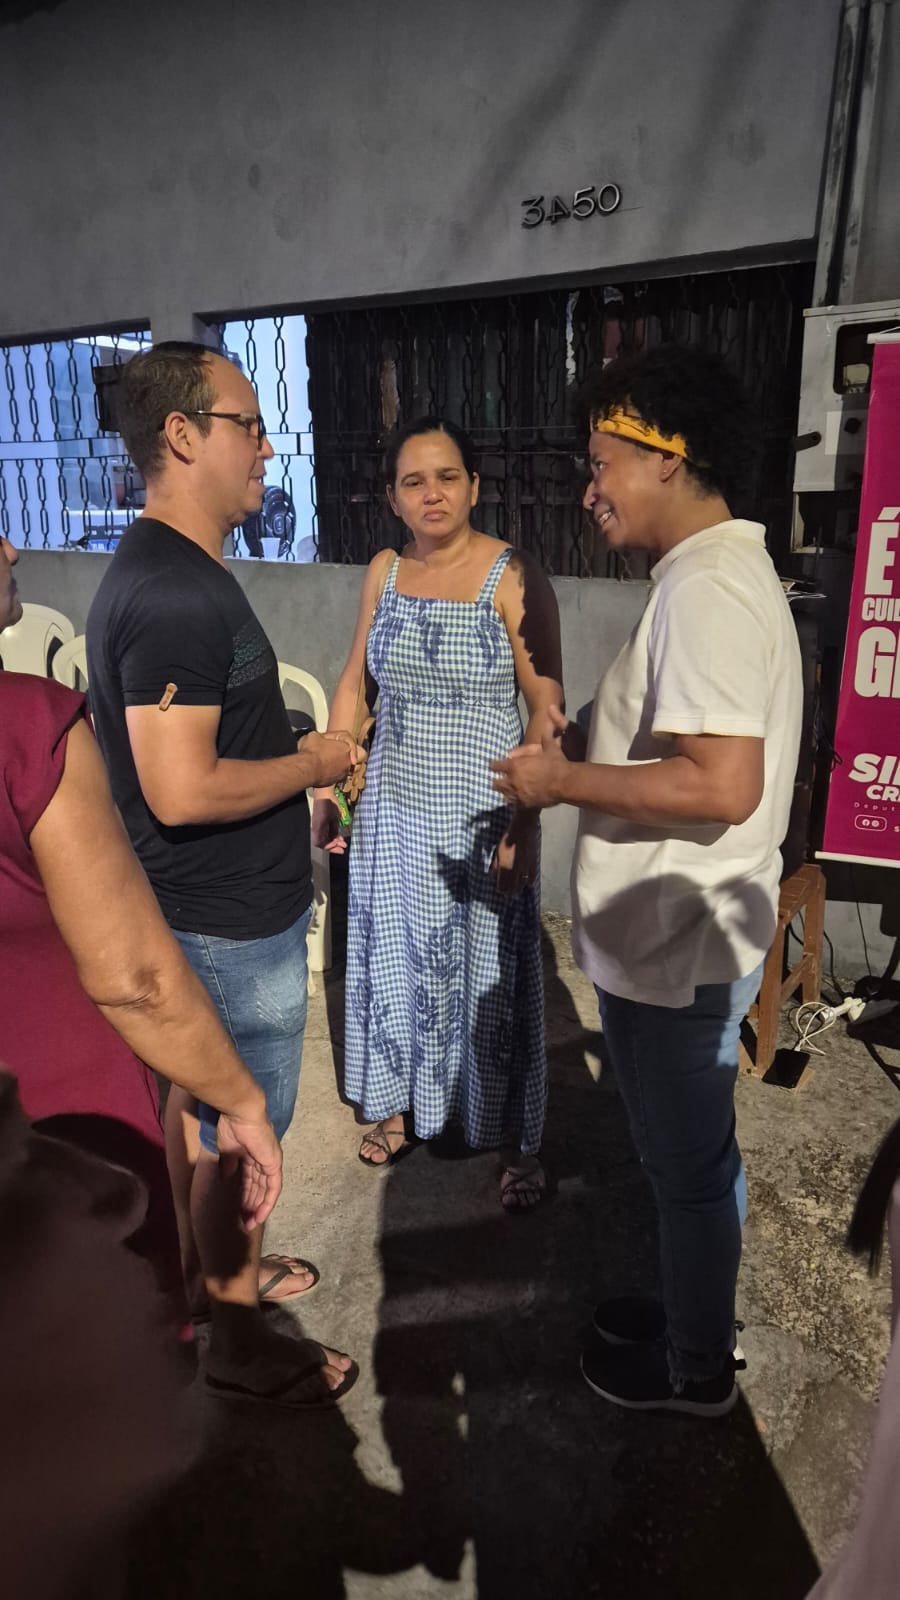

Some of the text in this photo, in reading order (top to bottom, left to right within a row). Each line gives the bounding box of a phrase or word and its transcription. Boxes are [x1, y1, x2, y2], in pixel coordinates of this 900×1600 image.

[521, 184, 621, 229] 3450
[854, 626, 900, 698] G
[848, 753, 900, 785] SI
[866, 785, 900, 802] CR
